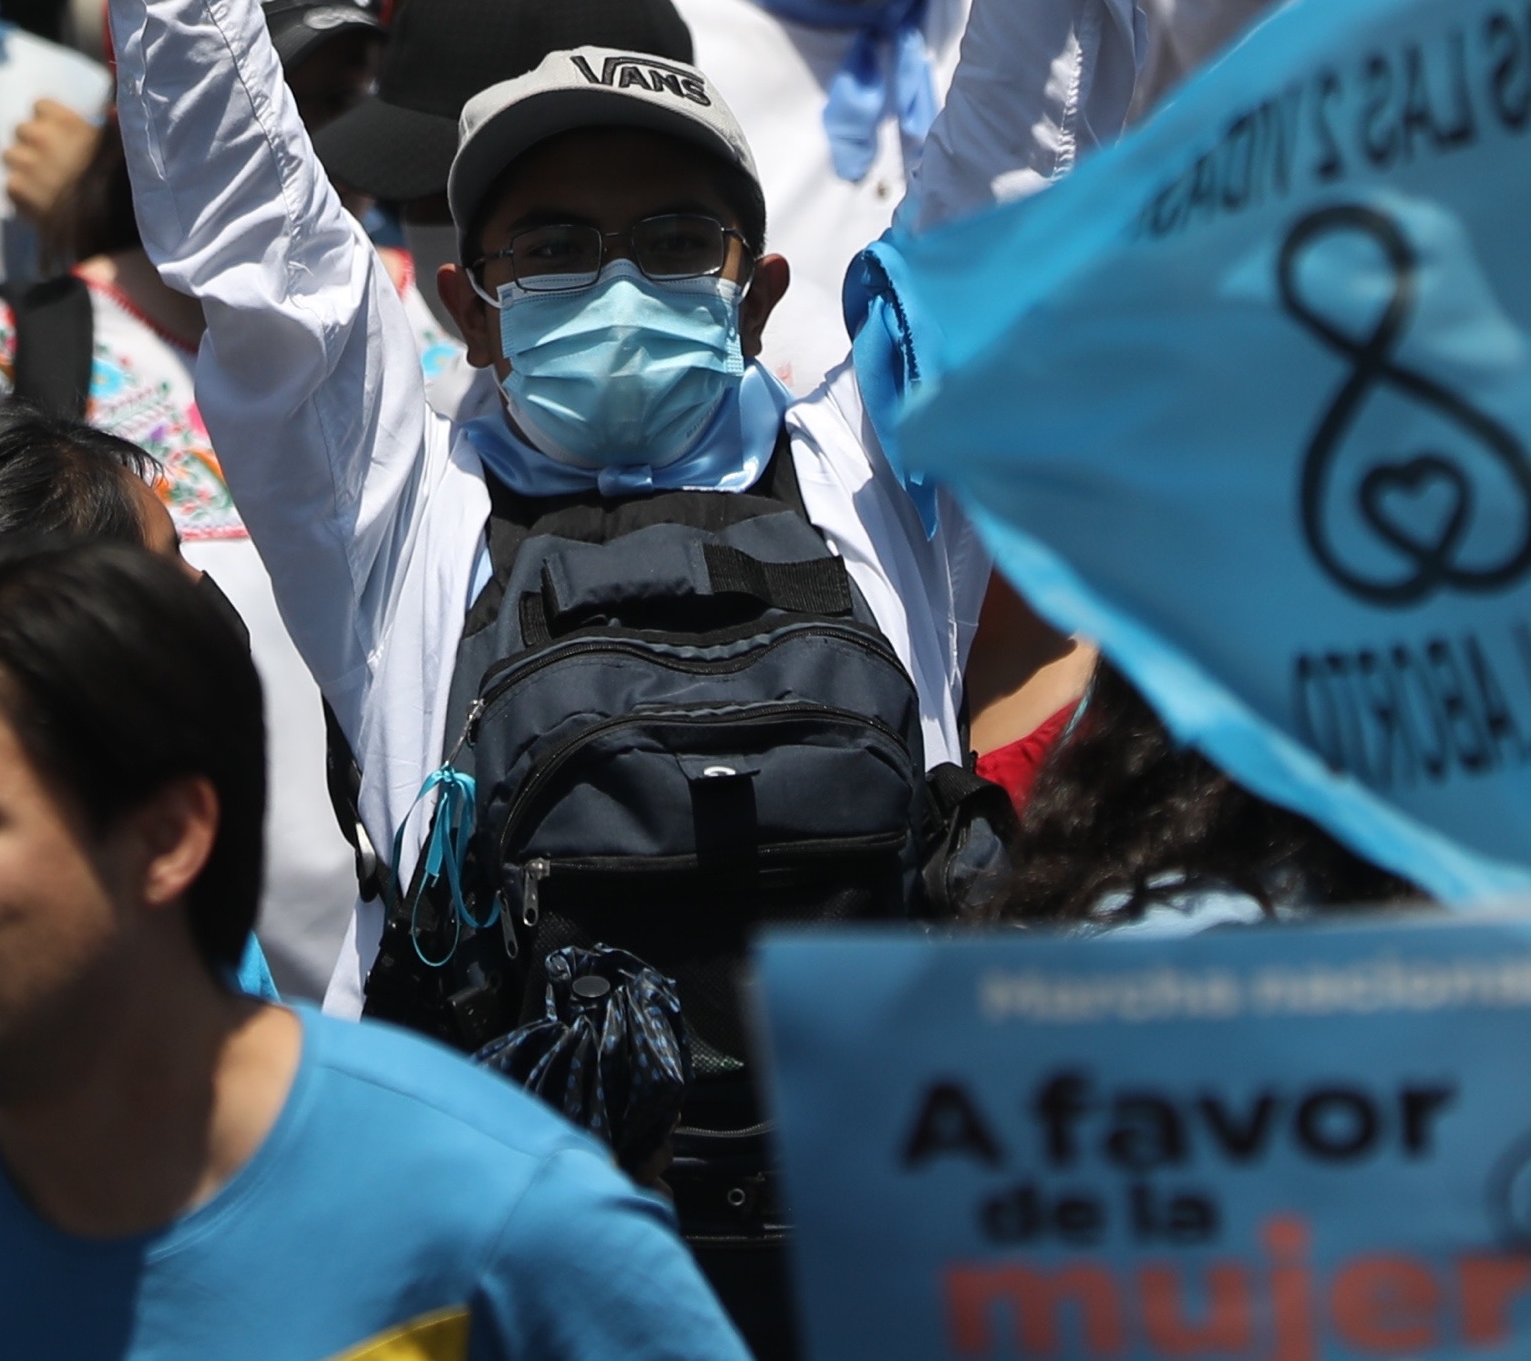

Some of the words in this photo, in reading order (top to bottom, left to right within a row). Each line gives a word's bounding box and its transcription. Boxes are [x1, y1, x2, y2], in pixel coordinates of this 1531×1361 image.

[570, 55, 712, 107] VANS
[900, 1076, 1004, 1171] A
[1030, 1063, 1462, 1167] favor
[979, 1182, 1105, 1247] de
[1127, 1179, 1221, 1246] la
